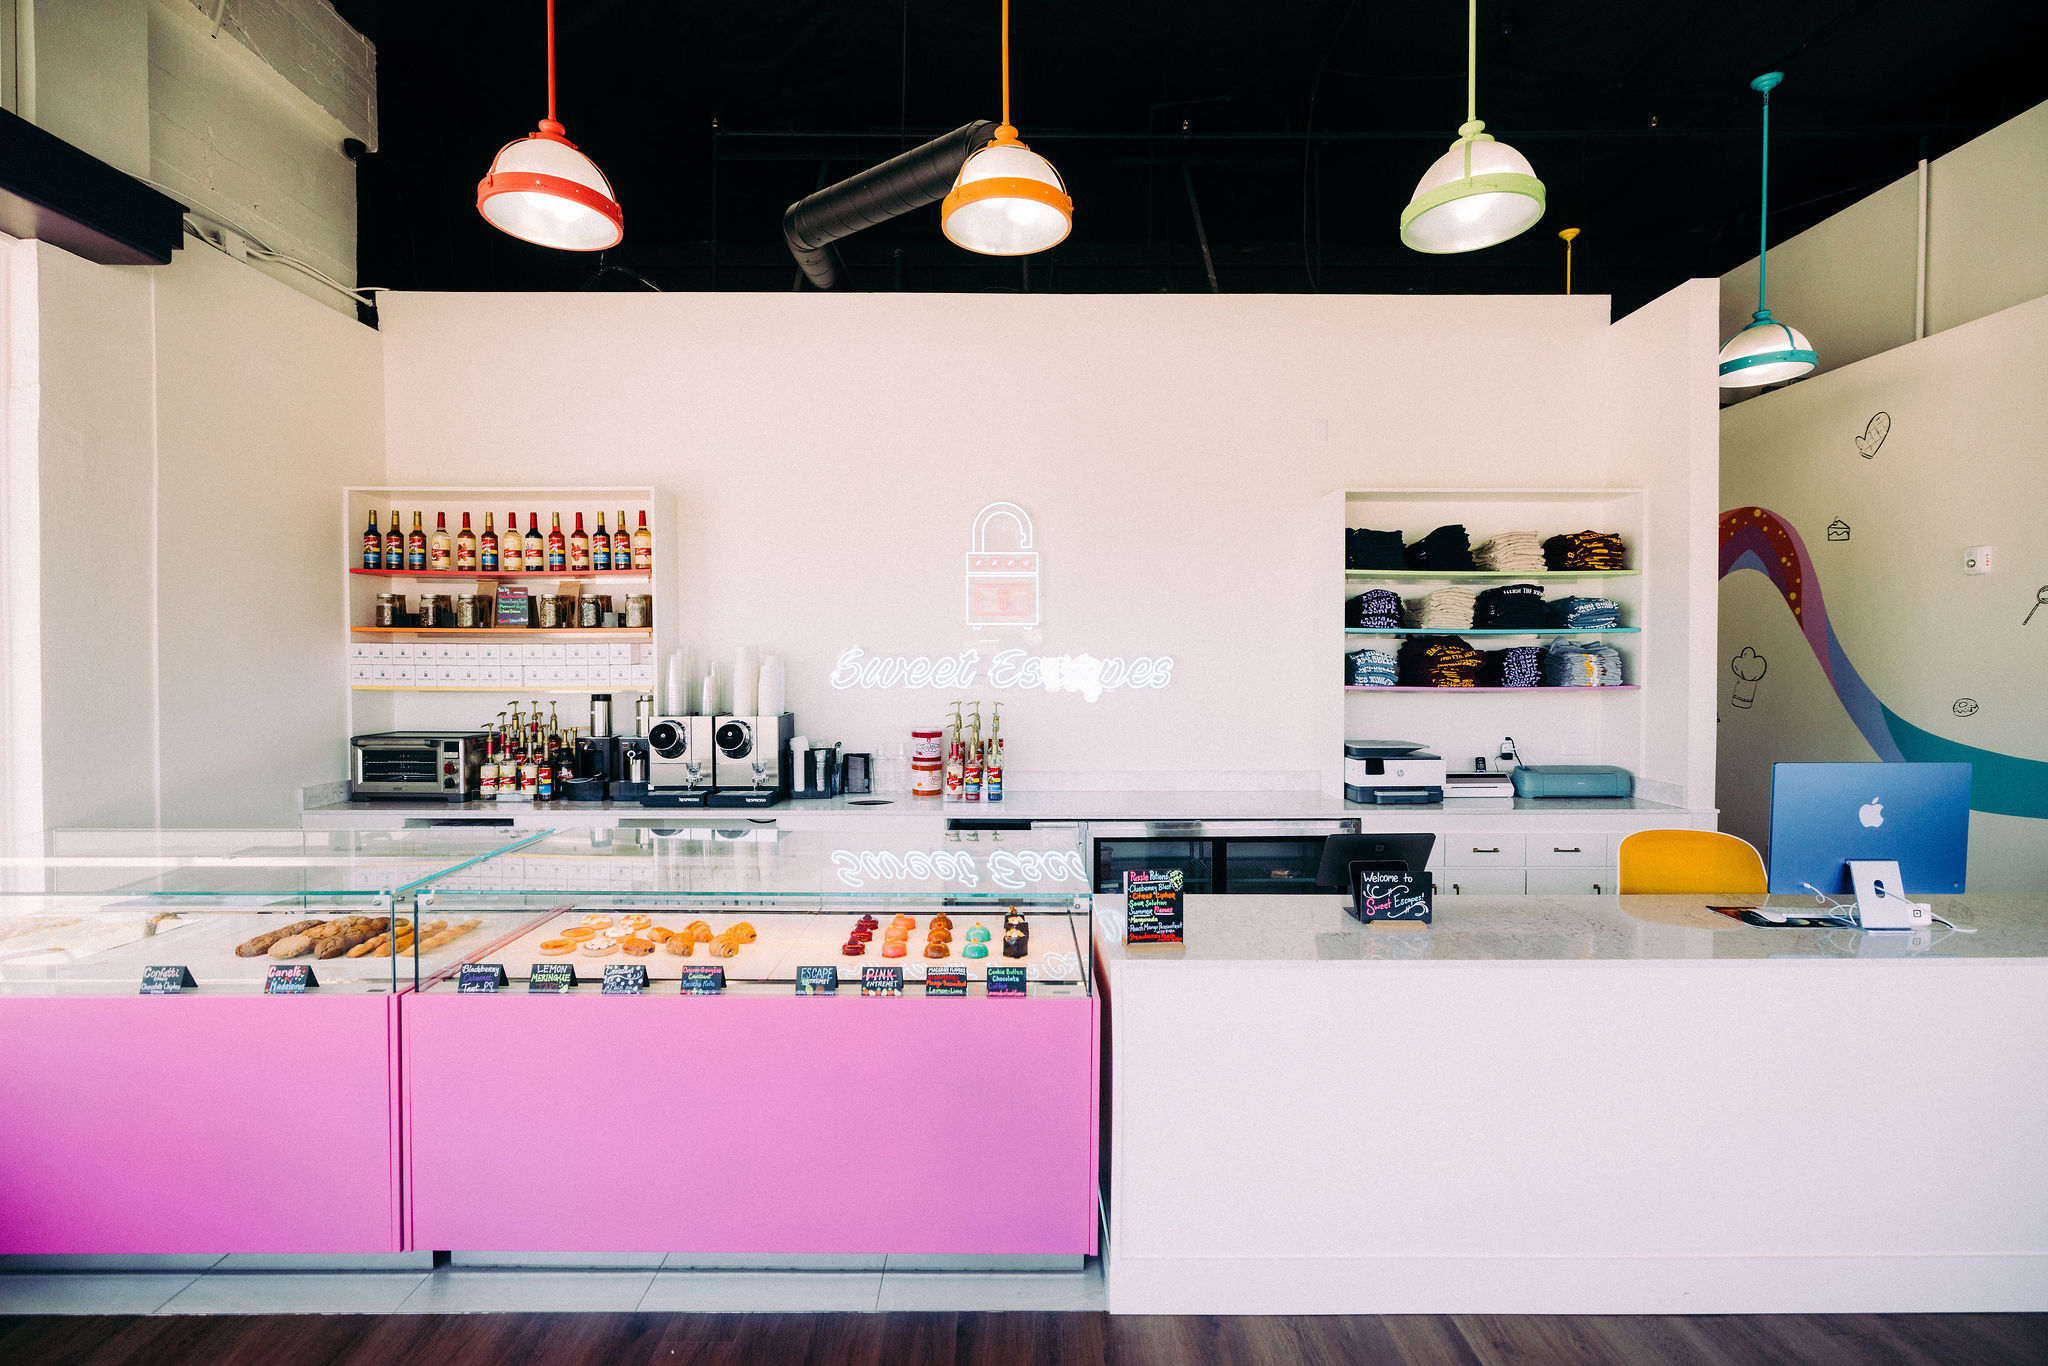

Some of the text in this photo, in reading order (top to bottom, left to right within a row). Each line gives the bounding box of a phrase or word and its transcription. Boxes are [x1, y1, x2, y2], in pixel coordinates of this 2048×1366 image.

[831, 646, 980, 689] Sweet
[1130, 870, 1170, 882] Puzzle Potions
[1363, 872, 1413, 882] Welcome to
[1366, 892, 1425, 916] Sweet Escapes!
[144, 967, 180, 978] Confetti
[462, 965, 500, 977] Blackberry
[537, 965, 568, 974] LEMON
[801, 967, 834, 980] ESCAPE
[866, 968, 894, 981] PINK
[531, 973, 571, 982] MERINGUE
[461, 982, 480, 993] Tart
[866, 980, 899, 988] ENTREMET
